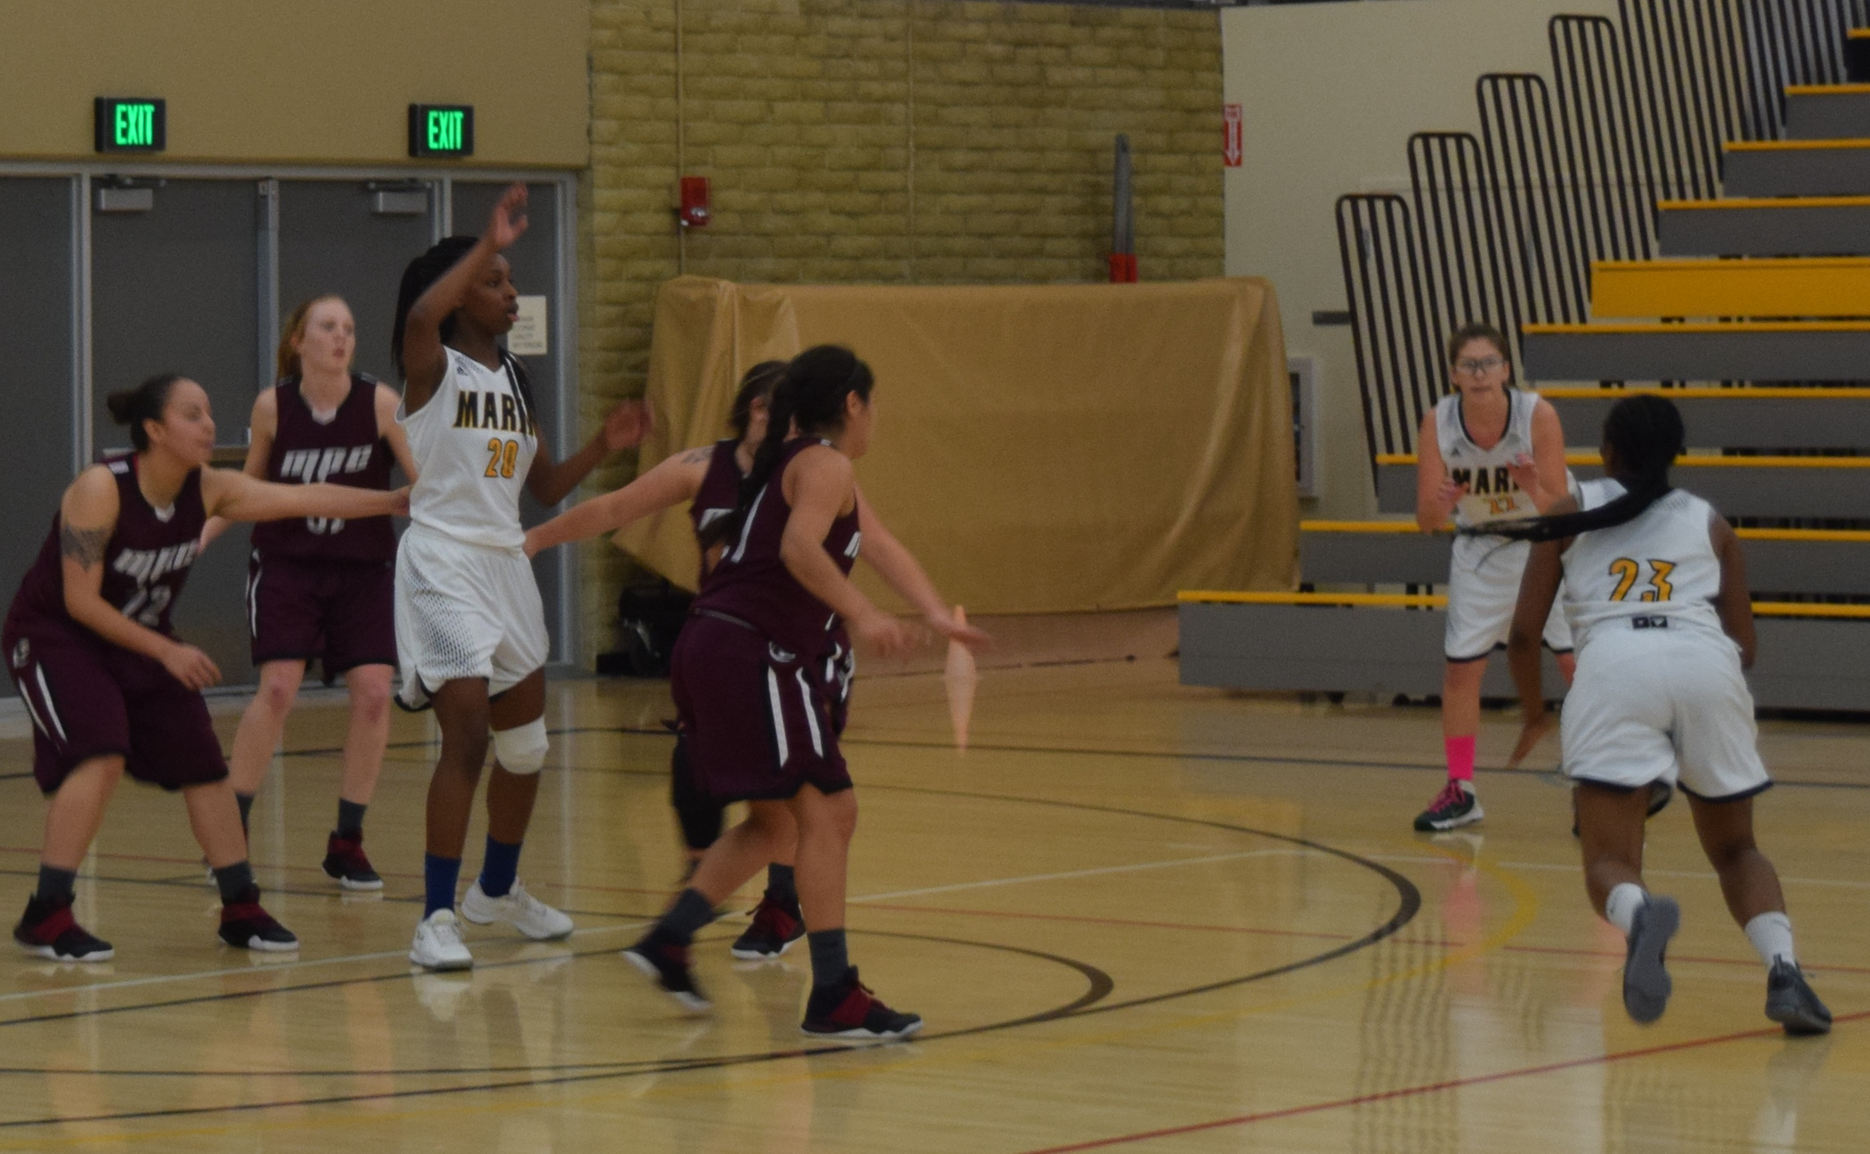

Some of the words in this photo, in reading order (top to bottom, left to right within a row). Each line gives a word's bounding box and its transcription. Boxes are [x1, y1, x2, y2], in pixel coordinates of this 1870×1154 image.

[115, 104, 155, 145] EXIT
[427, 111, 463, 150] EXIT
[484, 437, 519, 479] 20
[1608, 556, 1678, 603] 23
